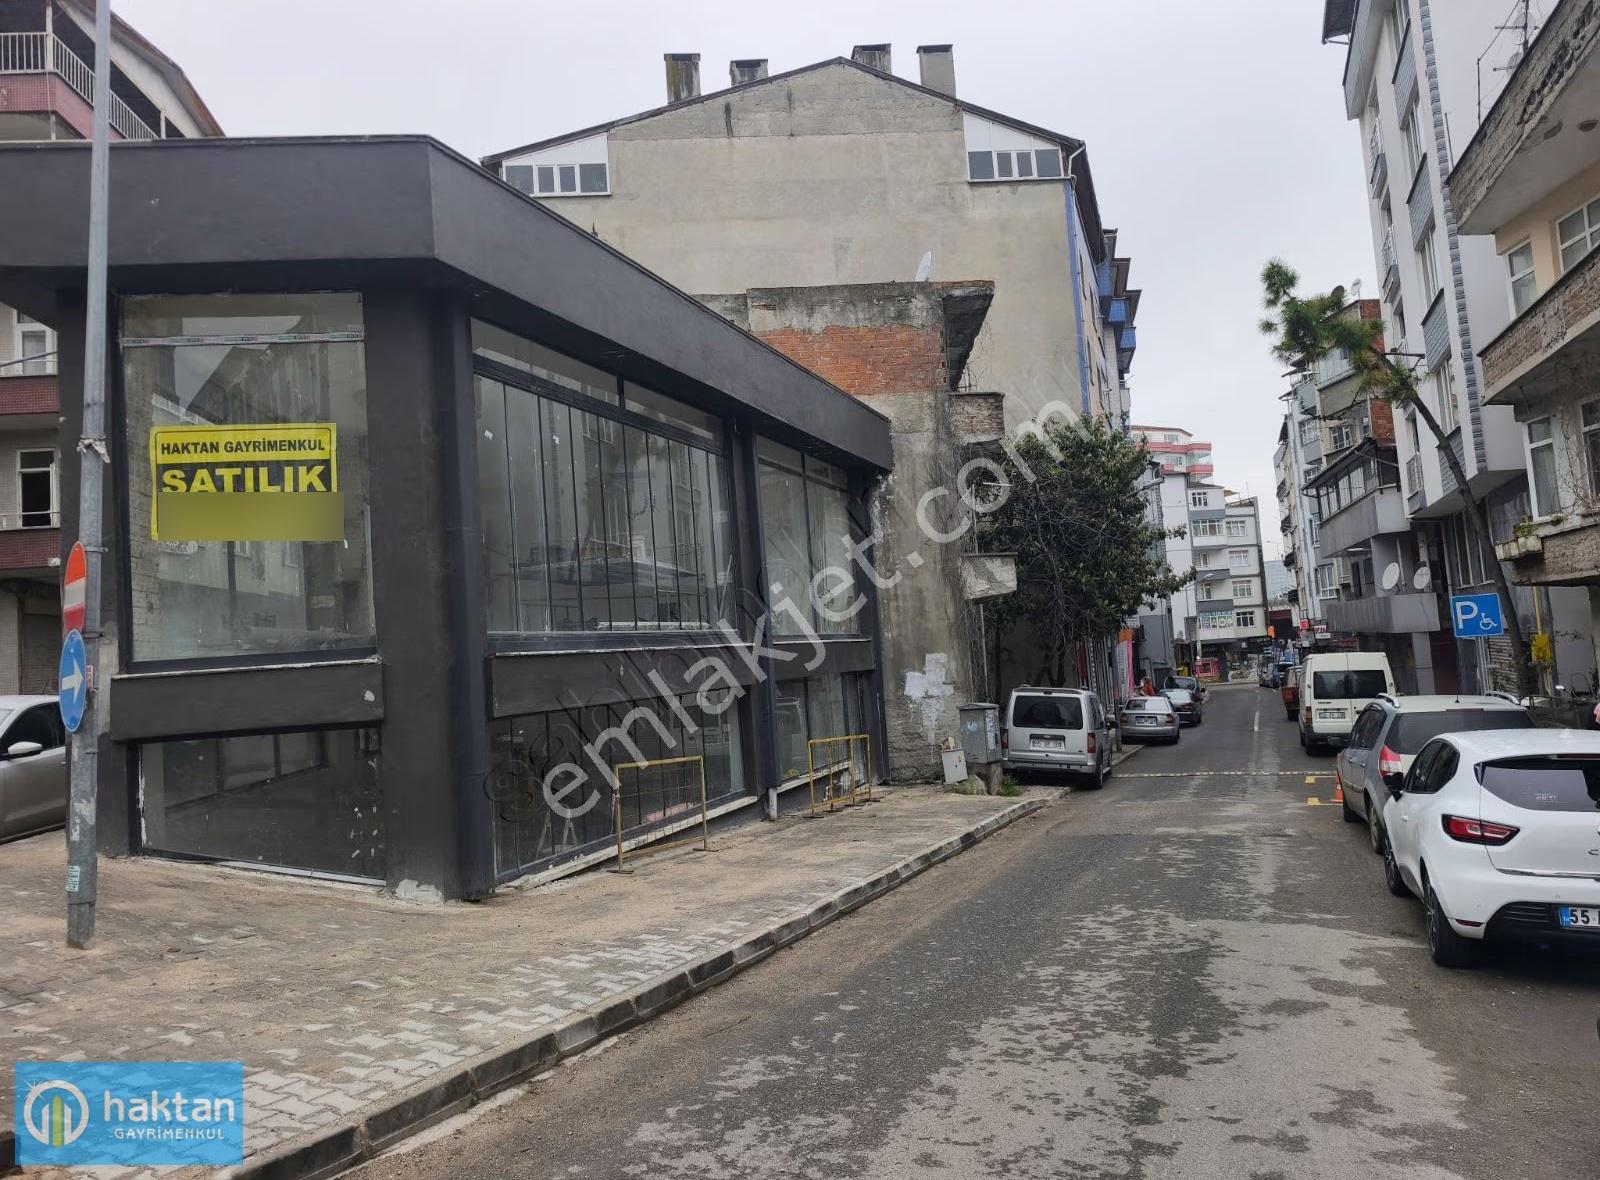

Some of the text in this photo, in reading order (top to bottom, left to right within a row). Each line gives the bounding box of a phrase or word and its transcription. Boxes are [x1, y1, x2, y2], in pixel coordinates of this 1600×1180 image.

[161, 437, 325, 455] HAKTAN GAYRİMENKUL
[161, 465, 327, 492] SATILIK
[1456, 601, 1478, 629] P
[1570, 908, 1590, 925] 55
